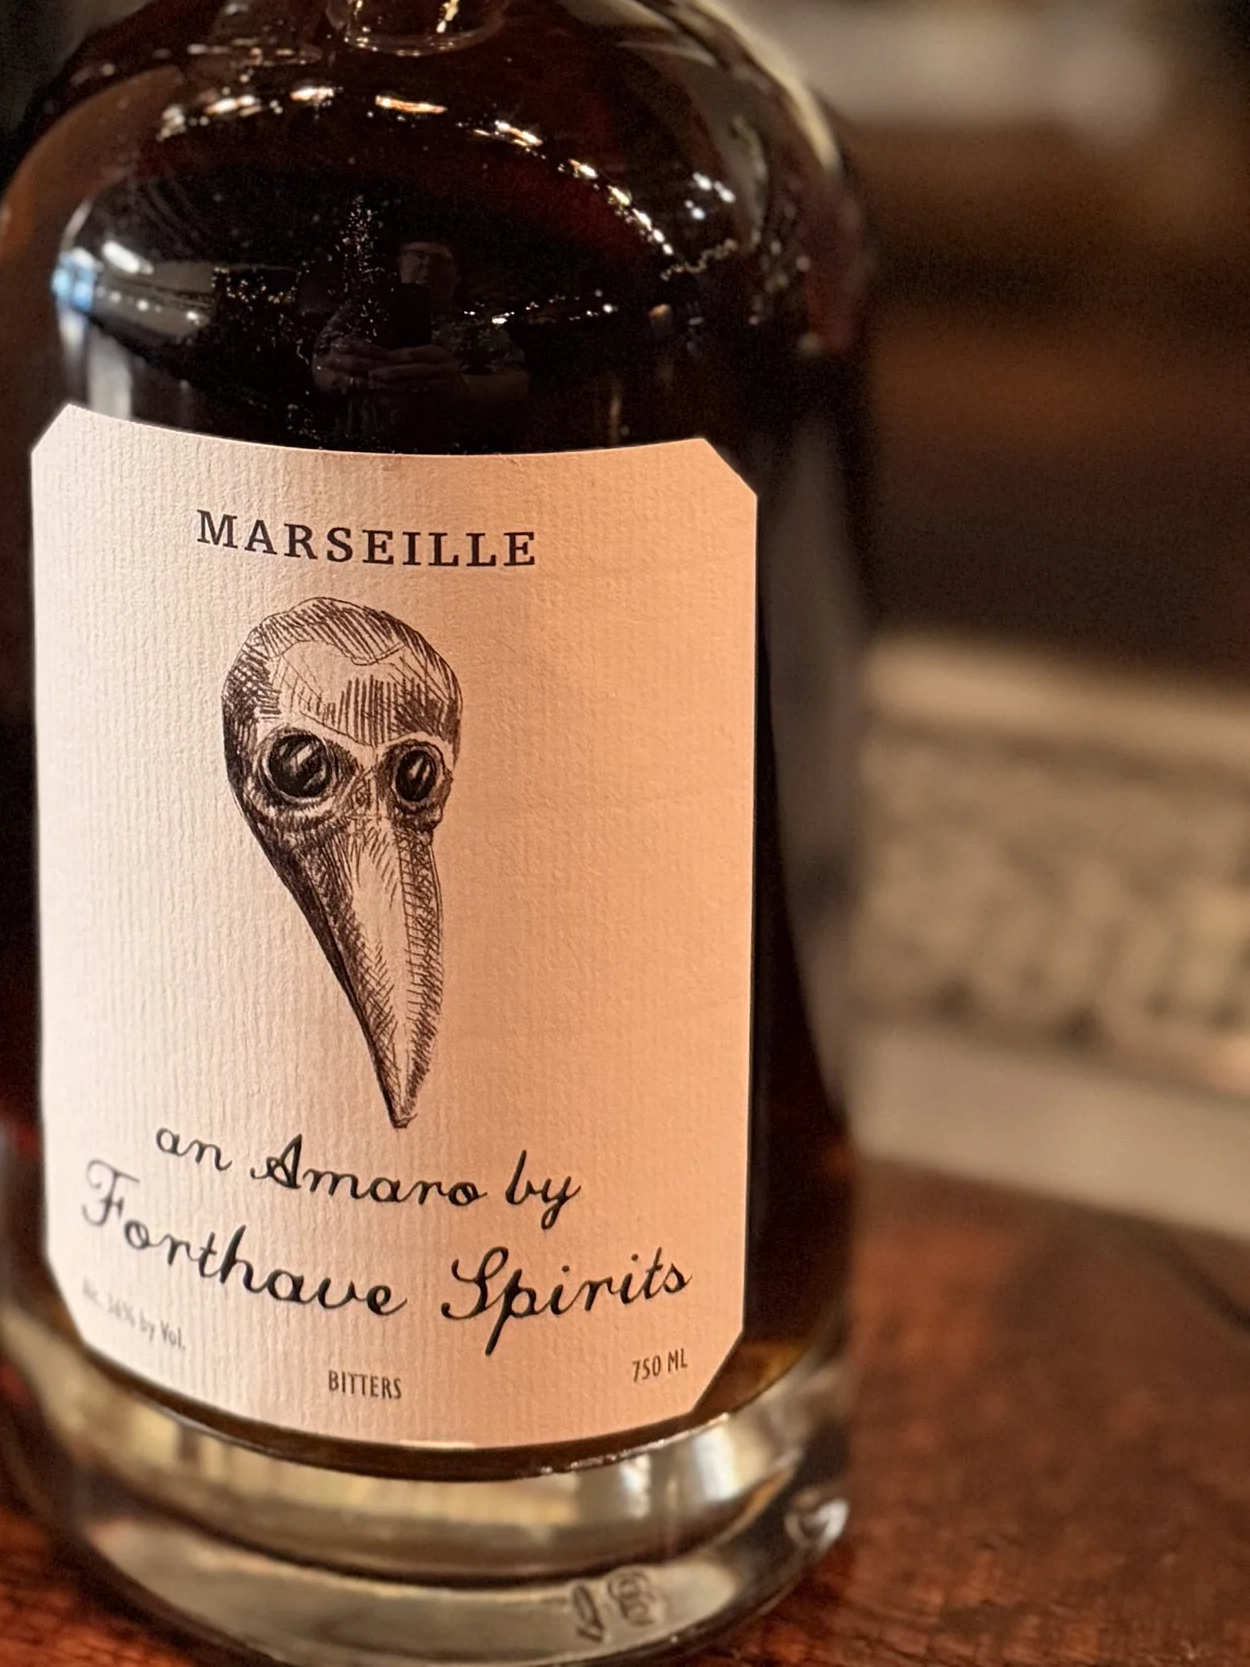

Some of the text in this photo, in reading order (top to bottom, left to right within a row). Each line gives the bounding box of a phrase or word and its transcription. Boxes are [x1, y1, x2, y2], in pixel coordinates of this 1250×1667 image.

[196, 508, 536, 567] MARSEILLE
[155, 1127, 582, 1230] an Amaro by
[82, 1158, 693, 1357] Forthave Spirits
[159, 1318, 187, 1351] Vol.
[328, 1369, 402, 1400] BITTERS
[631, 1347, 689, 1383] 750 ML
